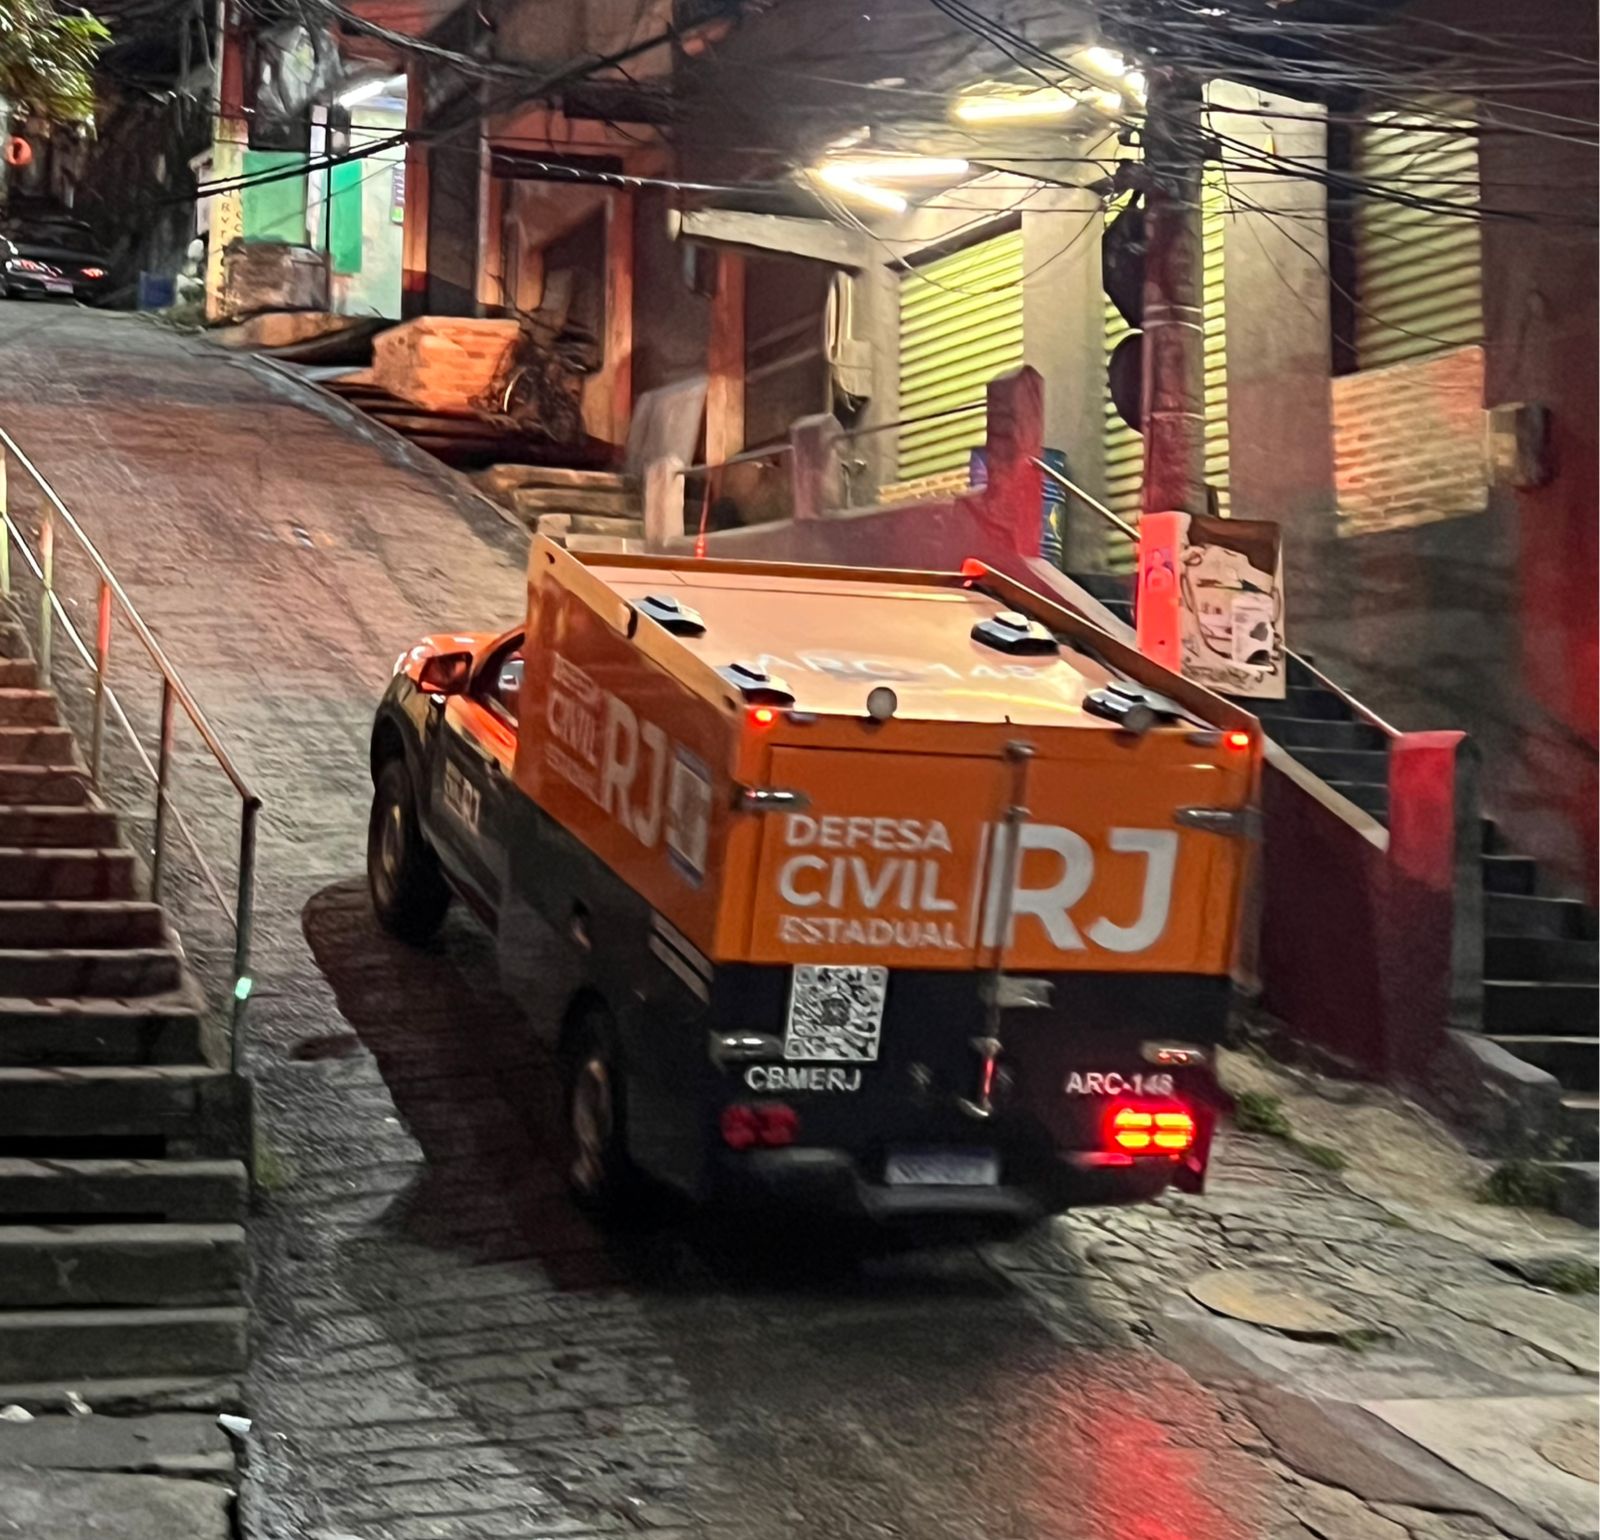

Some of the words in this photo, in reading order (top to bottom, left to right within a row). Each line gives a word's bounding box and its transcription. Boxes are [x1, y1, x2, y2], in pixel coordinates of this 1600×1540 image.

[601, 688, 669, 848] RJ
[786, 813, 952, 853] DEFESA
[779, 854, 958, 912] CIVIL
[982, 822, 1179, 954] RJ
[778, 913, 965, 950] ESTADUAL
[745, 1066, 861, 1092] CBMERJ
